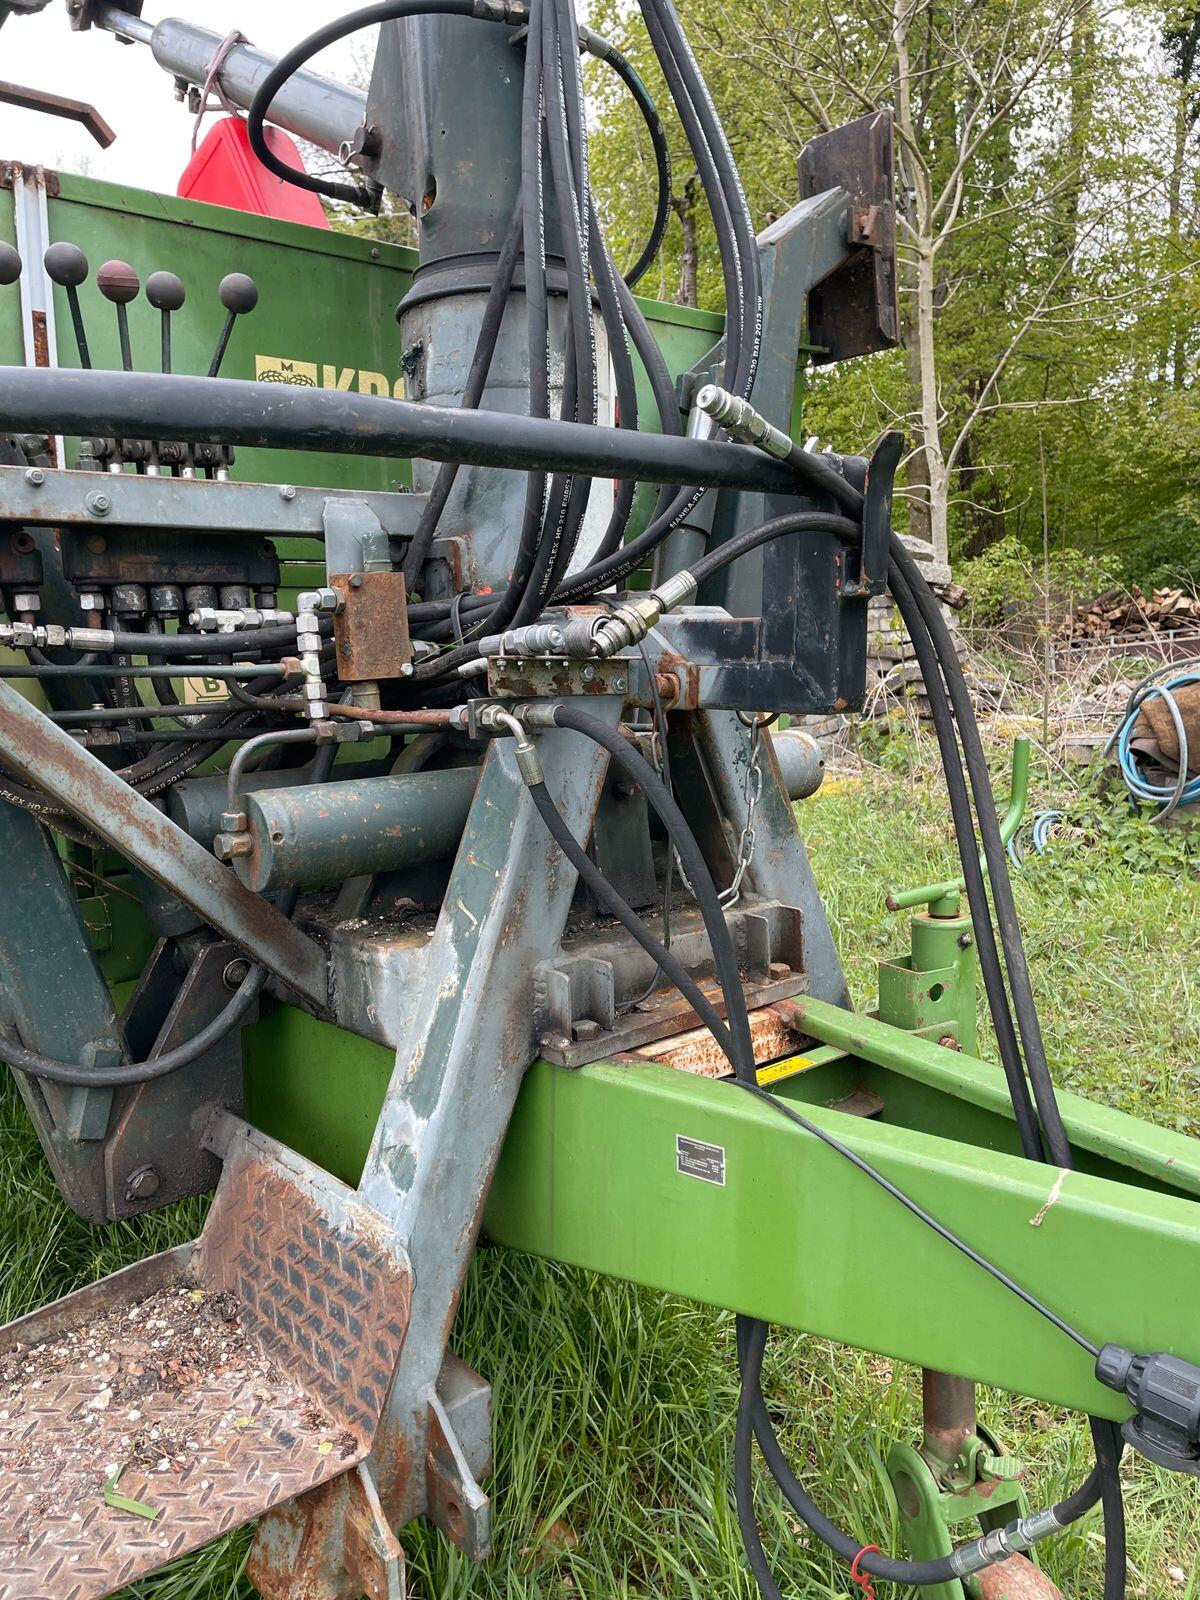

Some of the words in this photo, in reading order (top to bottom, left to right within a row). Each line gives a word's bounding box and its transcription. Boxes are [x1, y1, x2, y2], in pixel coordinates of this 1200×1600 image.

[752, 337, 760, 357] BAR
[281, 362, 293, 372] M
[749, 359, 757, 374] 330
[745, 375, 753, 390] WP
[558, 508, 566, 524] 210
[555, 525, 563, 539] HD
[557, 590, 569, 598] WP
[569, 585, 583, 593] 330
[582, 578, 599, 588] BAR
[28, 802, 41, 810] HD
